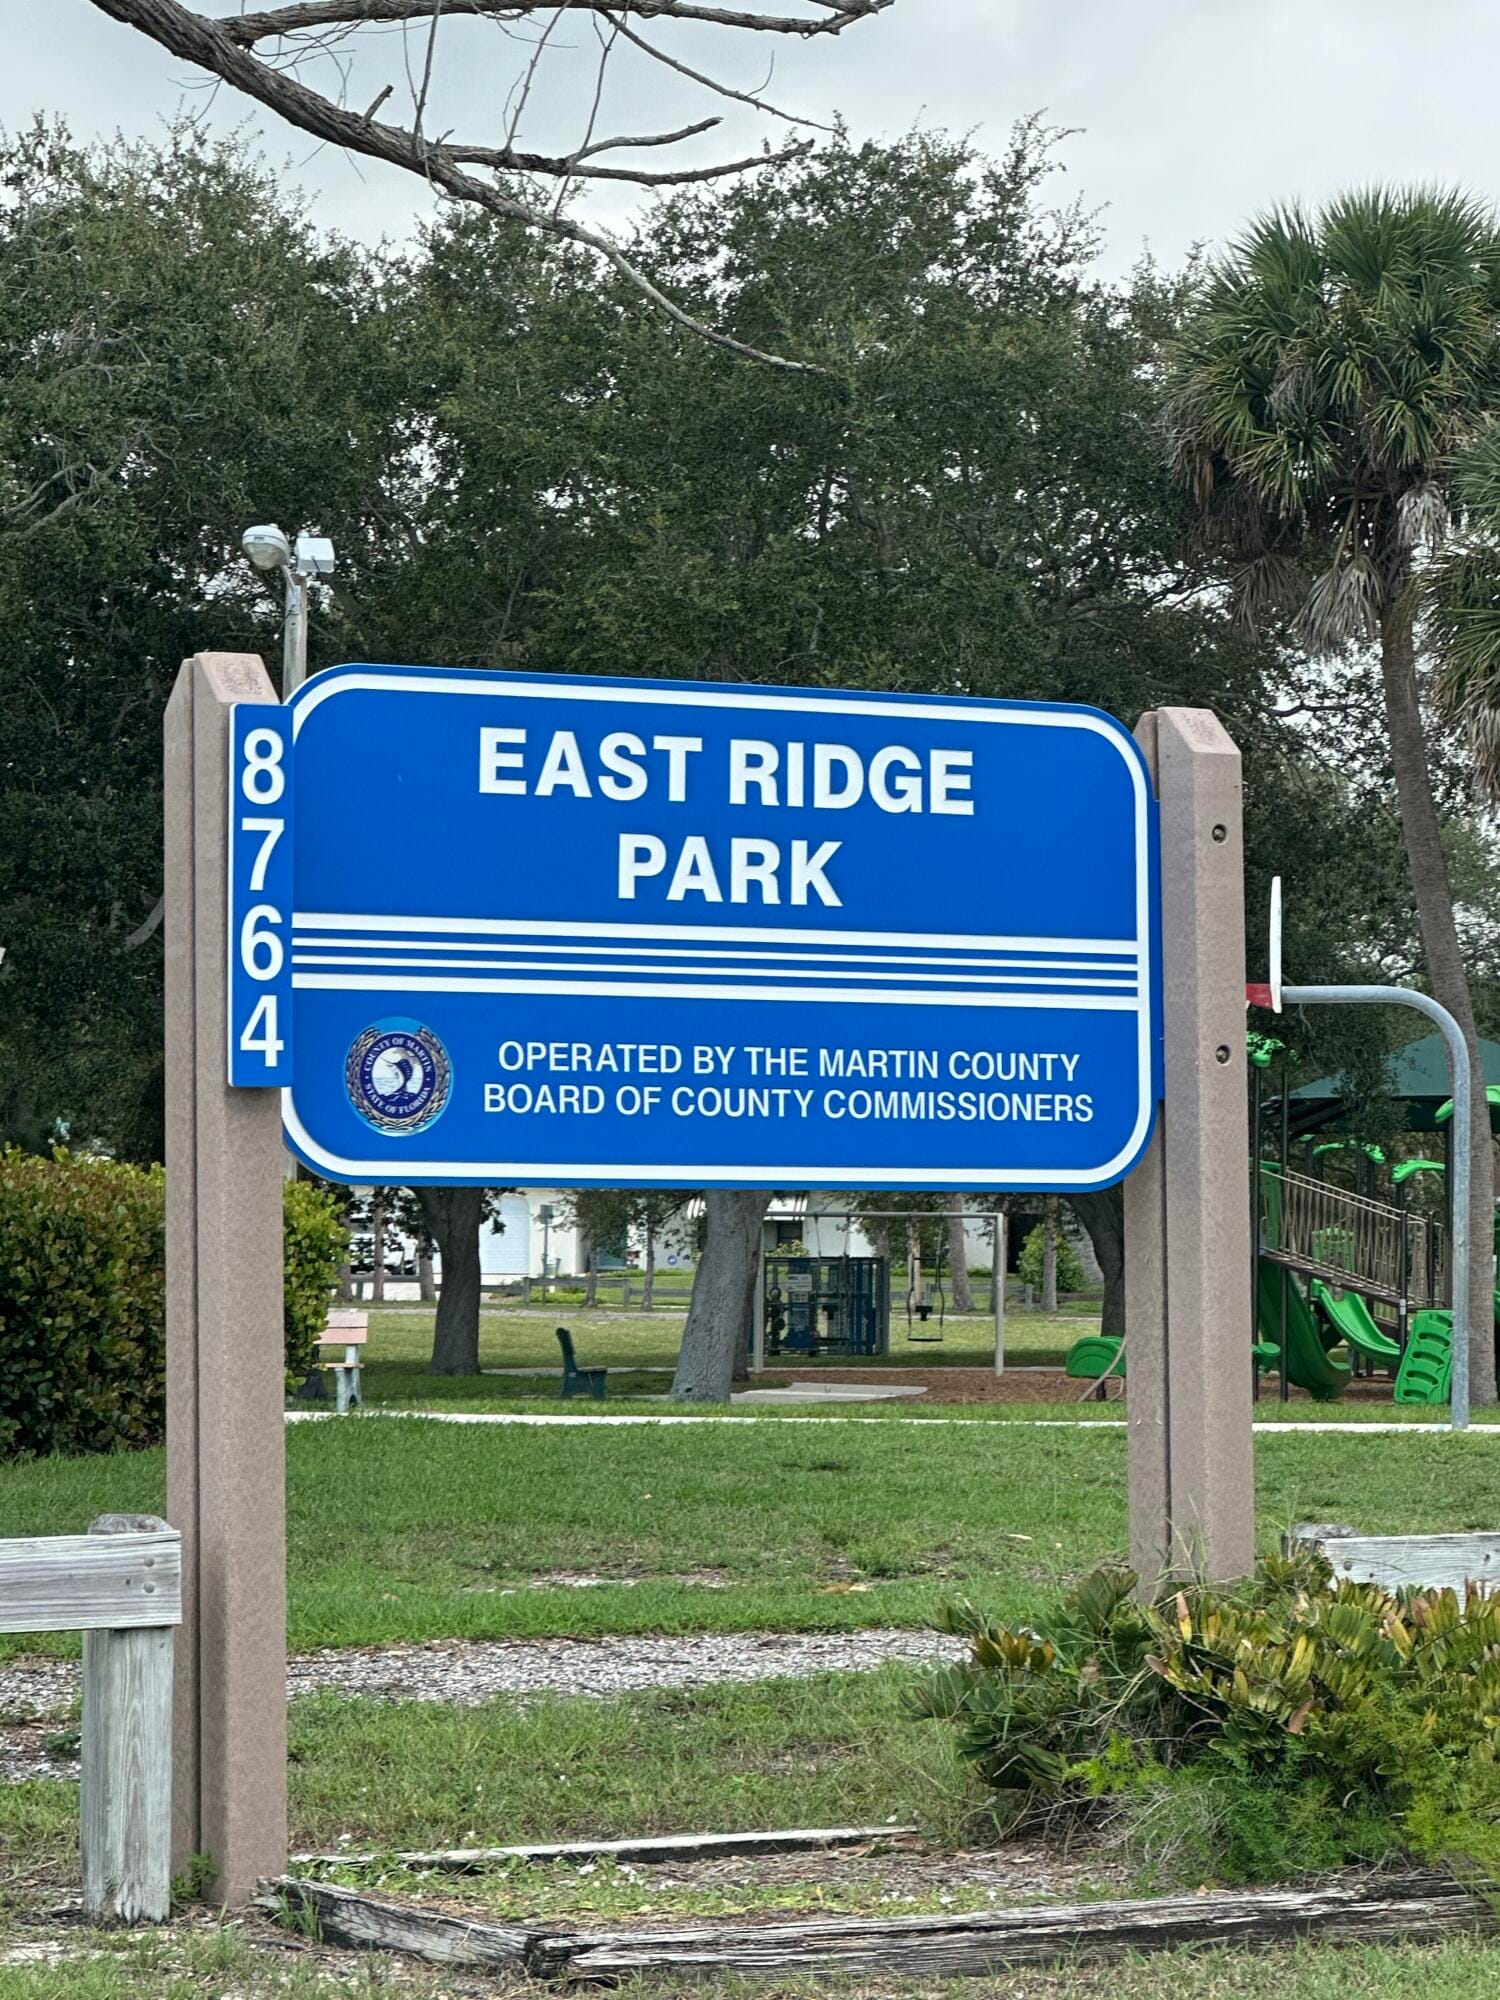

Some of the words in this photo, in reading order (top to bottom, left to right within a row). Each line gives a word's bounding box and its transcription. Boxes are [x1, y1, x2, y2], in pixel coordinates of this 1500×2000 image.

[478, 726, 704, 803] EAST
[729, 739, 975, 817] RIDGE
[618, 833, 844, 908] PARK
[239, 727, 286, 1069] 8764
[364, 1037, 391, 1072] COUNTY
[392, 1037, 405, 1046] OF
[406, 1038, 433, 1073] MARTIN
[498, 1040, 682, 1073] OPERATED
[693, 1045, 736, 1074] BY
[743, 1046, 809, 1076] THE
[819, 1048, 938, 1079] MARTIN
[948, 1050, 1080, 1082] COUNTY
[364, 1083, 383, 1109] STATE
[384, 1105, 398, 1114] OF
[398, 1087, 431, 1114] FLORIDA
[484, 1083, 605, 1114] BOARD
[615, 1085, 662, 1115] OF
[671, 1086, 814, 1118] COUNTY
[823, 1089, 1094, 1122] COMMISSIONERS
